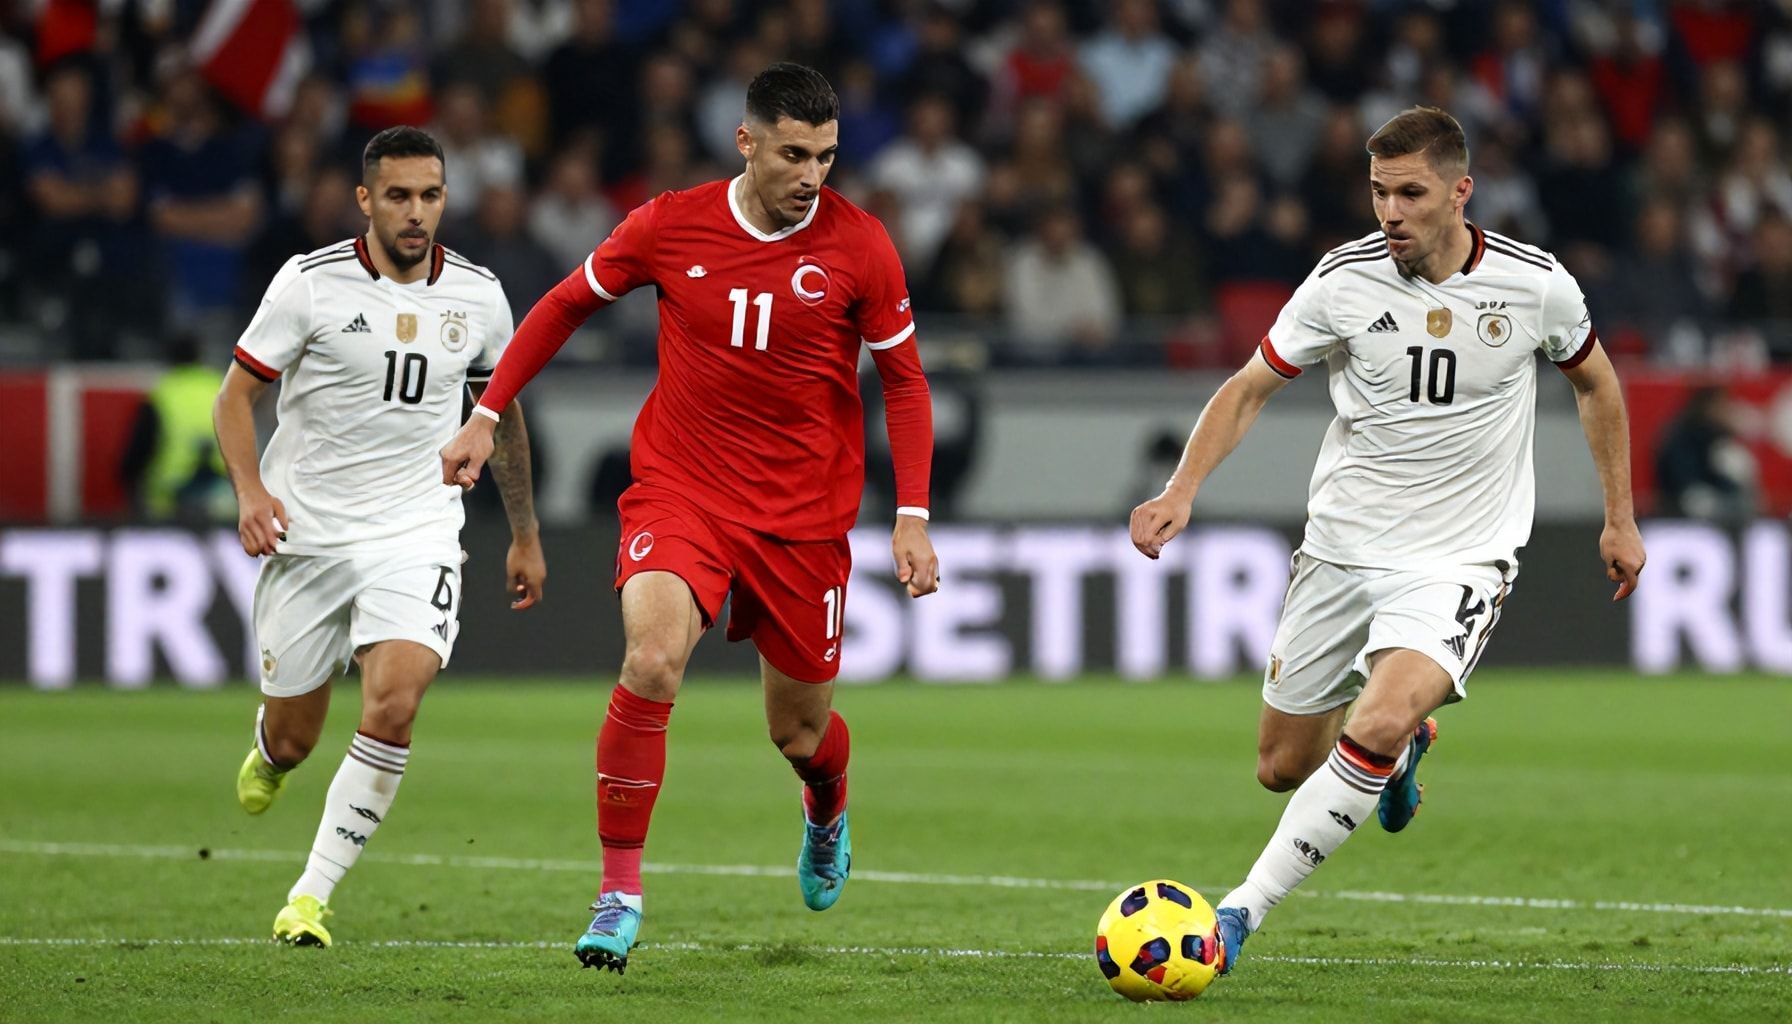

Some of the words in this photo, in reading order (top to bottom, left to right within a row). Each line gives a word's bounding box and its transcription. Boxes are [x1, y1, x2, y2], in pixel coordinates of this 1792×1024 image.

[729, 288, 774, 351] 11
[383, 350, 428, 405] 10
[1406, 345, 1457, 406] 10
